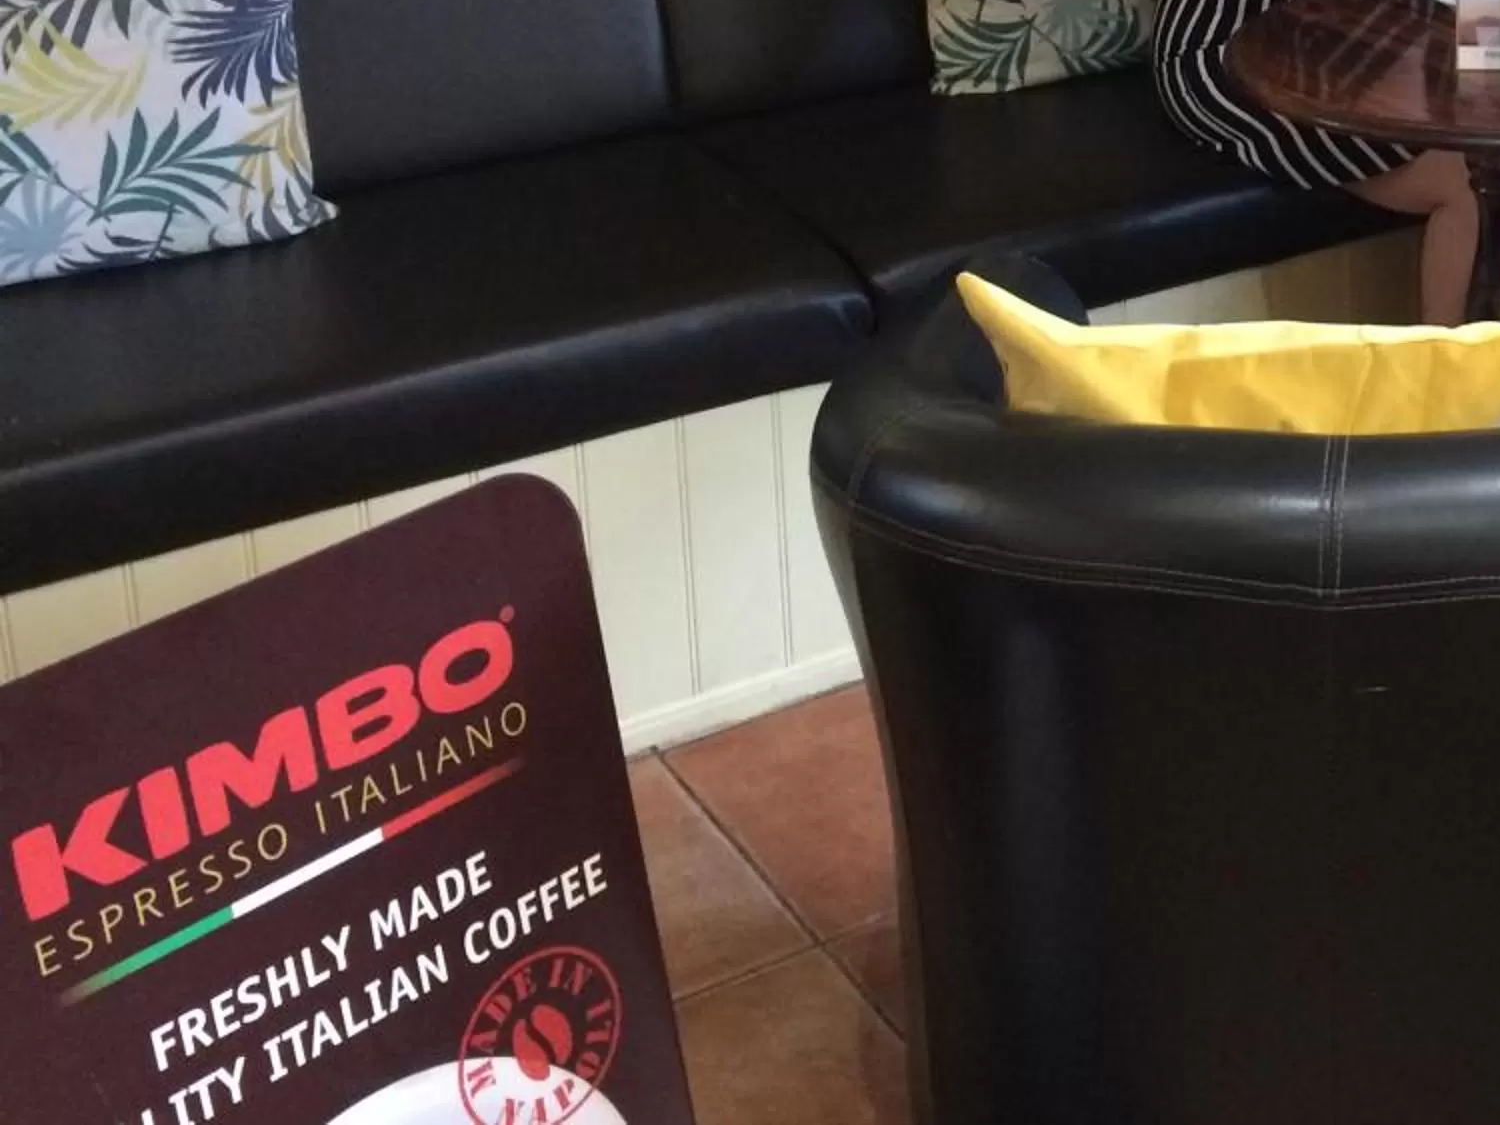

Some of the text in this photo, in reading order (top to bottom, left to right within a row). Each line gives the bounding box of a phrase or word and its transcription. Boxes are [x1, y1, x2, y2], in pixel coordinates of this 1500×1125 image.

[12, 620, 513, 921] KIMBO
[33, 702, 527, 977] ESPRESSO ITALIANO
[150, 851, 493, 1072] FRESHLY MADE
[262, 944, 449, 1082] ITALIAN
[464, 853, 608, 964] COFFEE
[467, 966, 537, 1099] MADE
[548, 957, 593, 996] IN
